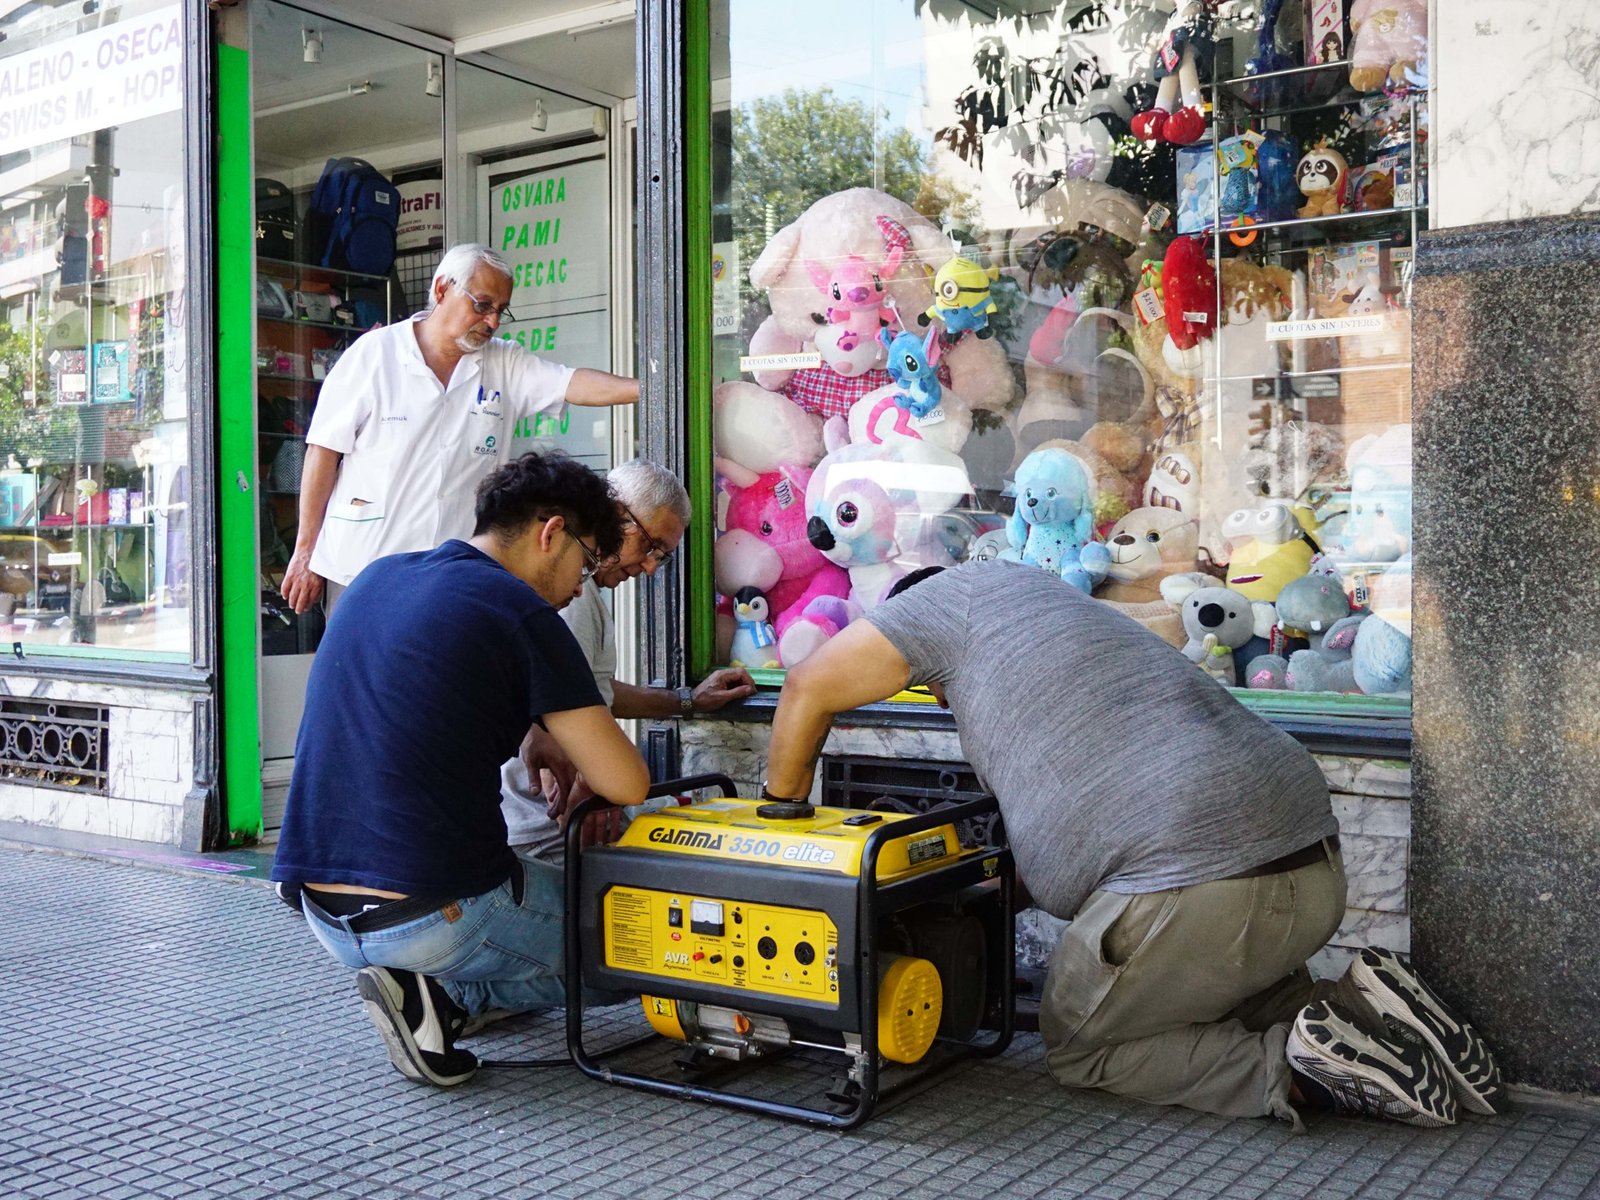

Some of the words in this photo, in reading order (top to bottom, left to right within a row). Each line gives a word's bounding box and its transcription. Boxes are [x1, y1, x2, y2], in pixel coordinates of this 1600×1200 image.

[1, 51, 74, 97] ALENO
[97, 18, 181, 70] OSECA
[0, 95, 67, 141] SWISS
[401, 192, 443, 214] traFl
[502, 176, 566, 212] OSVARA
[502, 218, 561, 251] PAMI
[1278, 323, 1317, 334] CUOTAS
[1320, 321, 1336, 330] SIN
[1340, 318, 1381, 329] INTERES
[649, 827, 723, 850] GAMMA
[729, 836, 781, 857] 3500
[782, 842, 835, 864] elite
[664, 951, 689, 965] AVR
